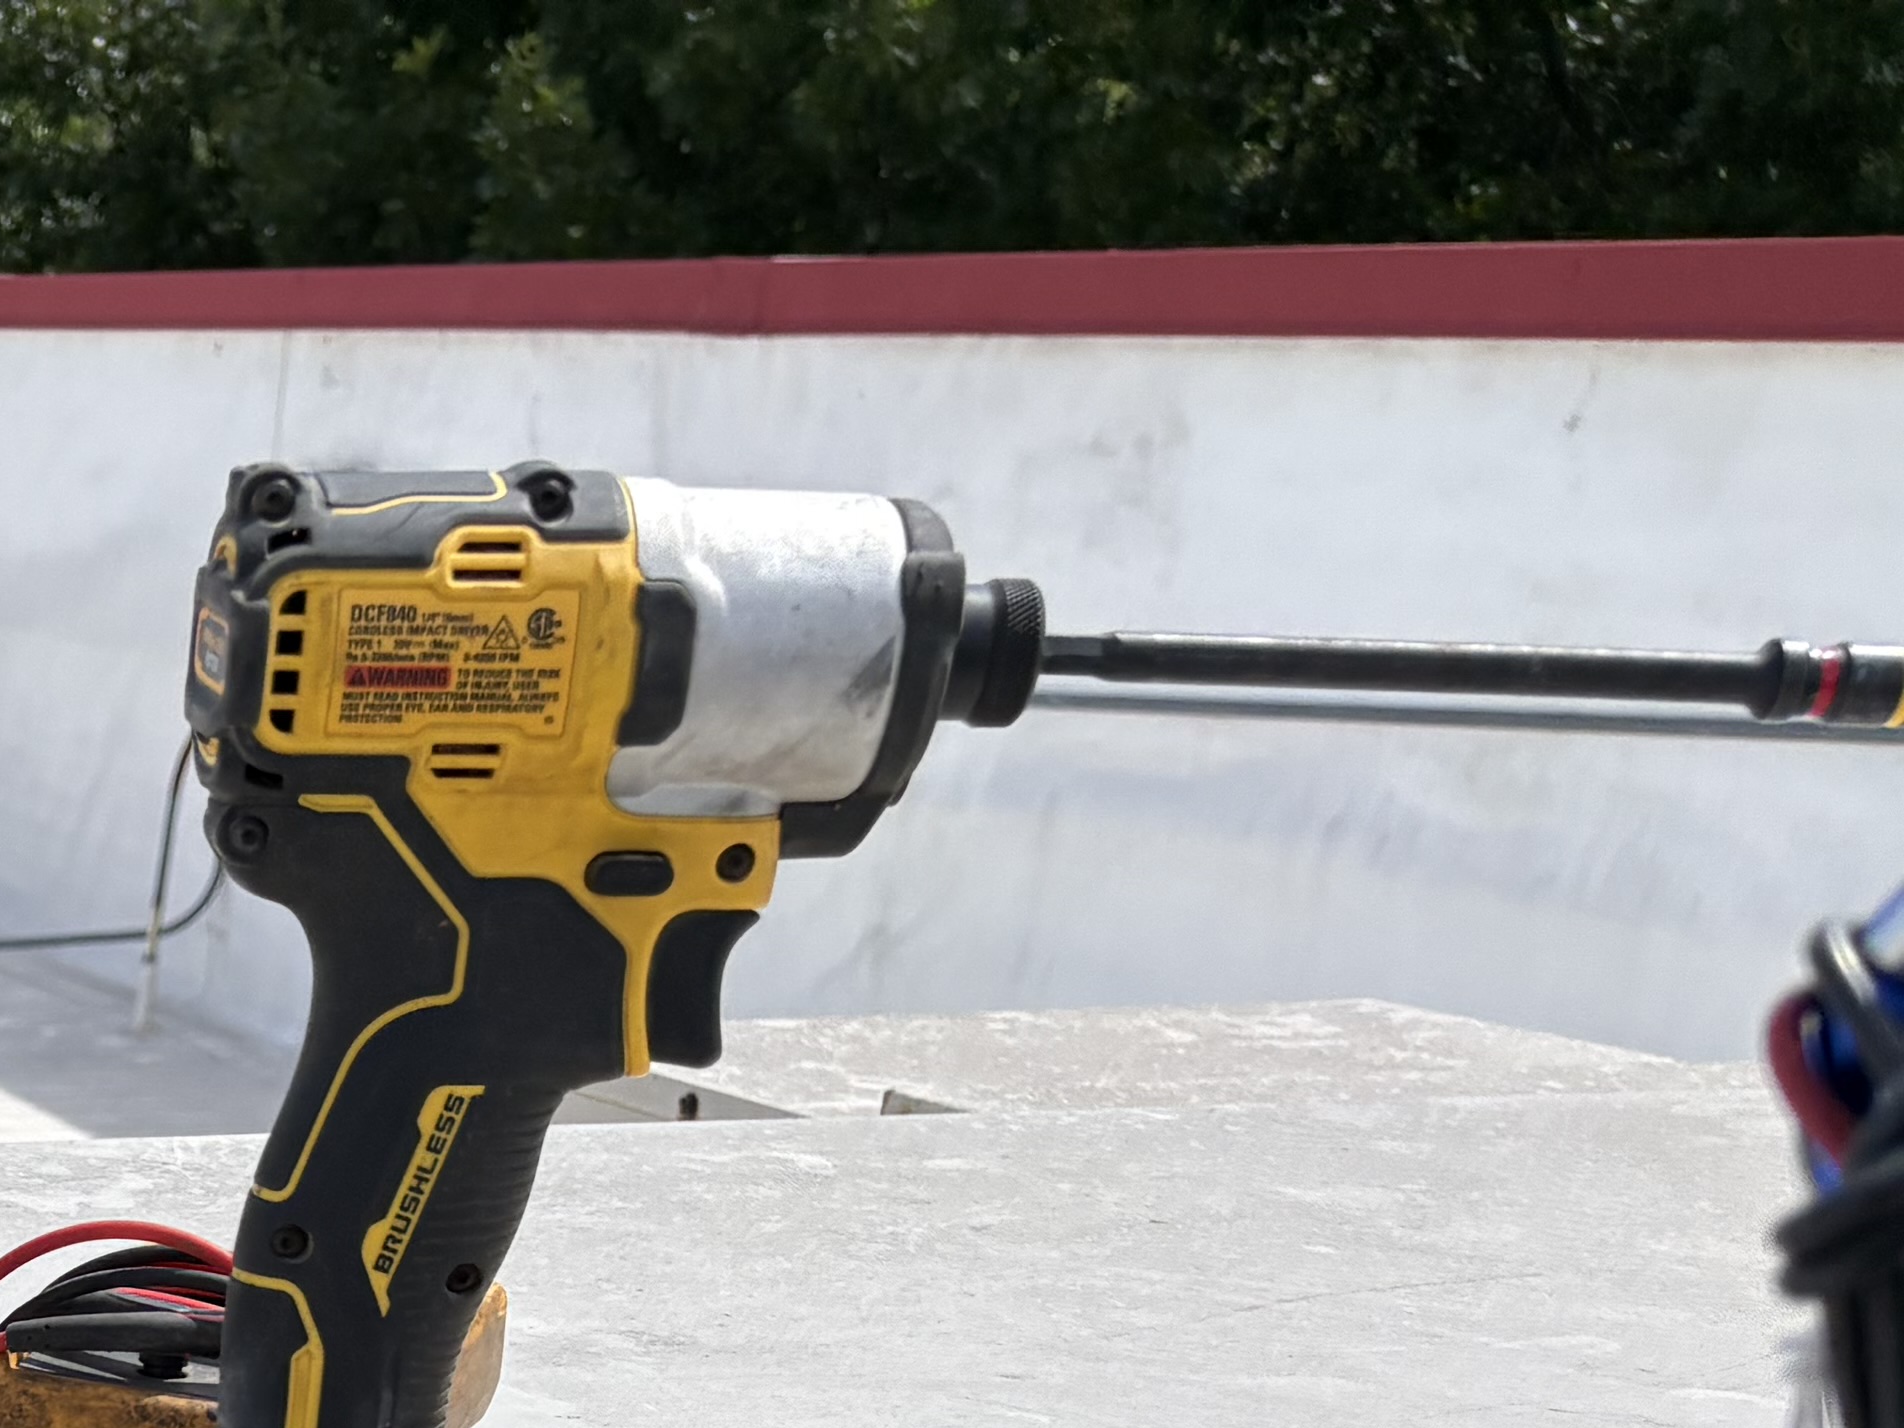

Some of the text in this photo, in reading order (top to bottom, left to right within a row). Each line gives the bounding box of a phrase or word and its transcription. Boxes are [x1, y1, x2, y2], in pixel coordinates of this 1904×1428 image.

[351, 604, 417, 622] DCF840
[349, 624, 489, 637] CORDLESS IMPACT DRIVER
[348, 639, 373, 650] TYPE
[368, 667, 449, 687] WARNING
[457, 668, 470, 679] TO
[472, 668, 512, 679] REDUCE
[515, 668, 535, 679] THE
[456, 680, 468, 690] OF
[512, 680, 540, 690] USER
[342, 691, 371, 702] MUST
[373, 691, 399, 702] READ
[401, 691, 468, 702] INSTRUCTION
[518, 691, 559, 702] ALWAYS
[341, 702, 360, 713] USE
[363, 702, 403, 713] PROPER
[429, 702, 450, 713] EAR
[451, 702, 473, 713] AND
[476, 702, 545, 713] RESPIRATORY
[372, 1093, 467, 1275] BRUSHLESS
